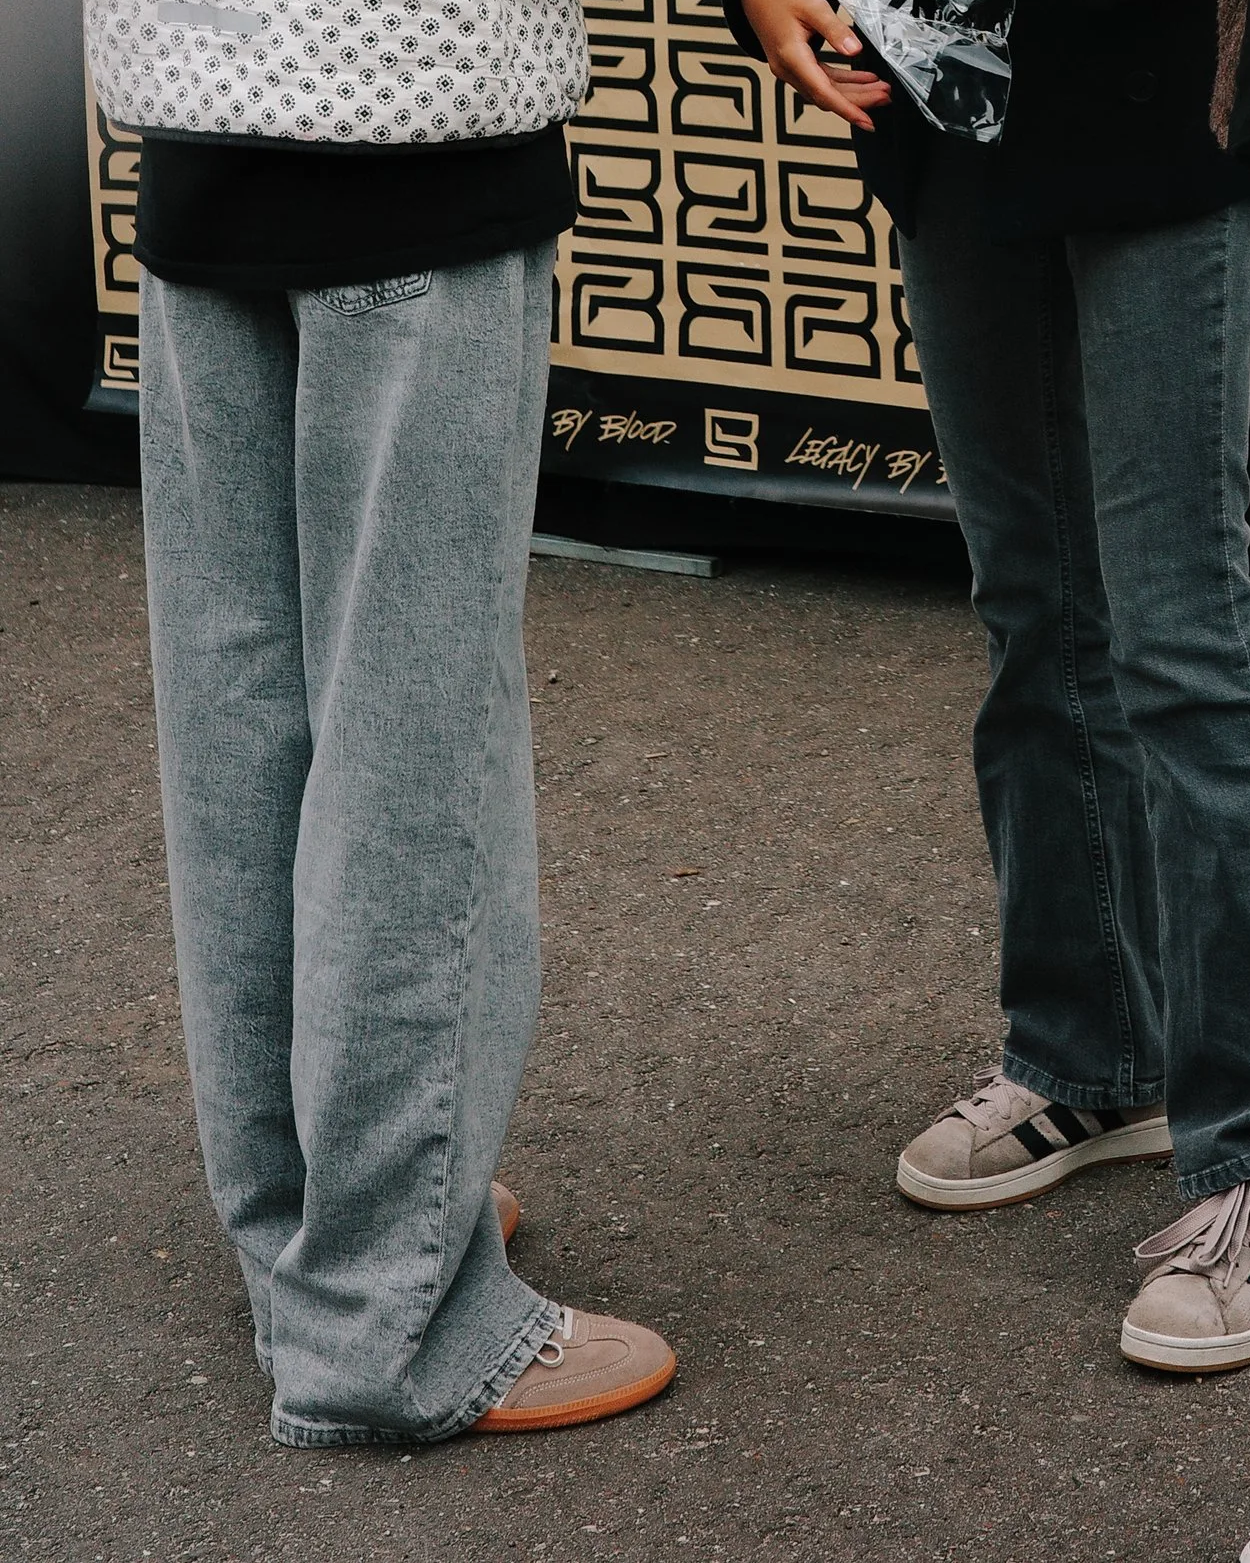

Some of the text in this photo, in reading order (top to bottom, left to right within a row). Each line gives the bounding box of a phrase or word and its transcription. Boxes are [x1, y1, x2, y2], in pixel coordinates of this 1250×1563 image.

[551, 408, 592, 451] BY
[784, 426, 880, 490] LEGACY
[885, 449, 932, 494] BY
